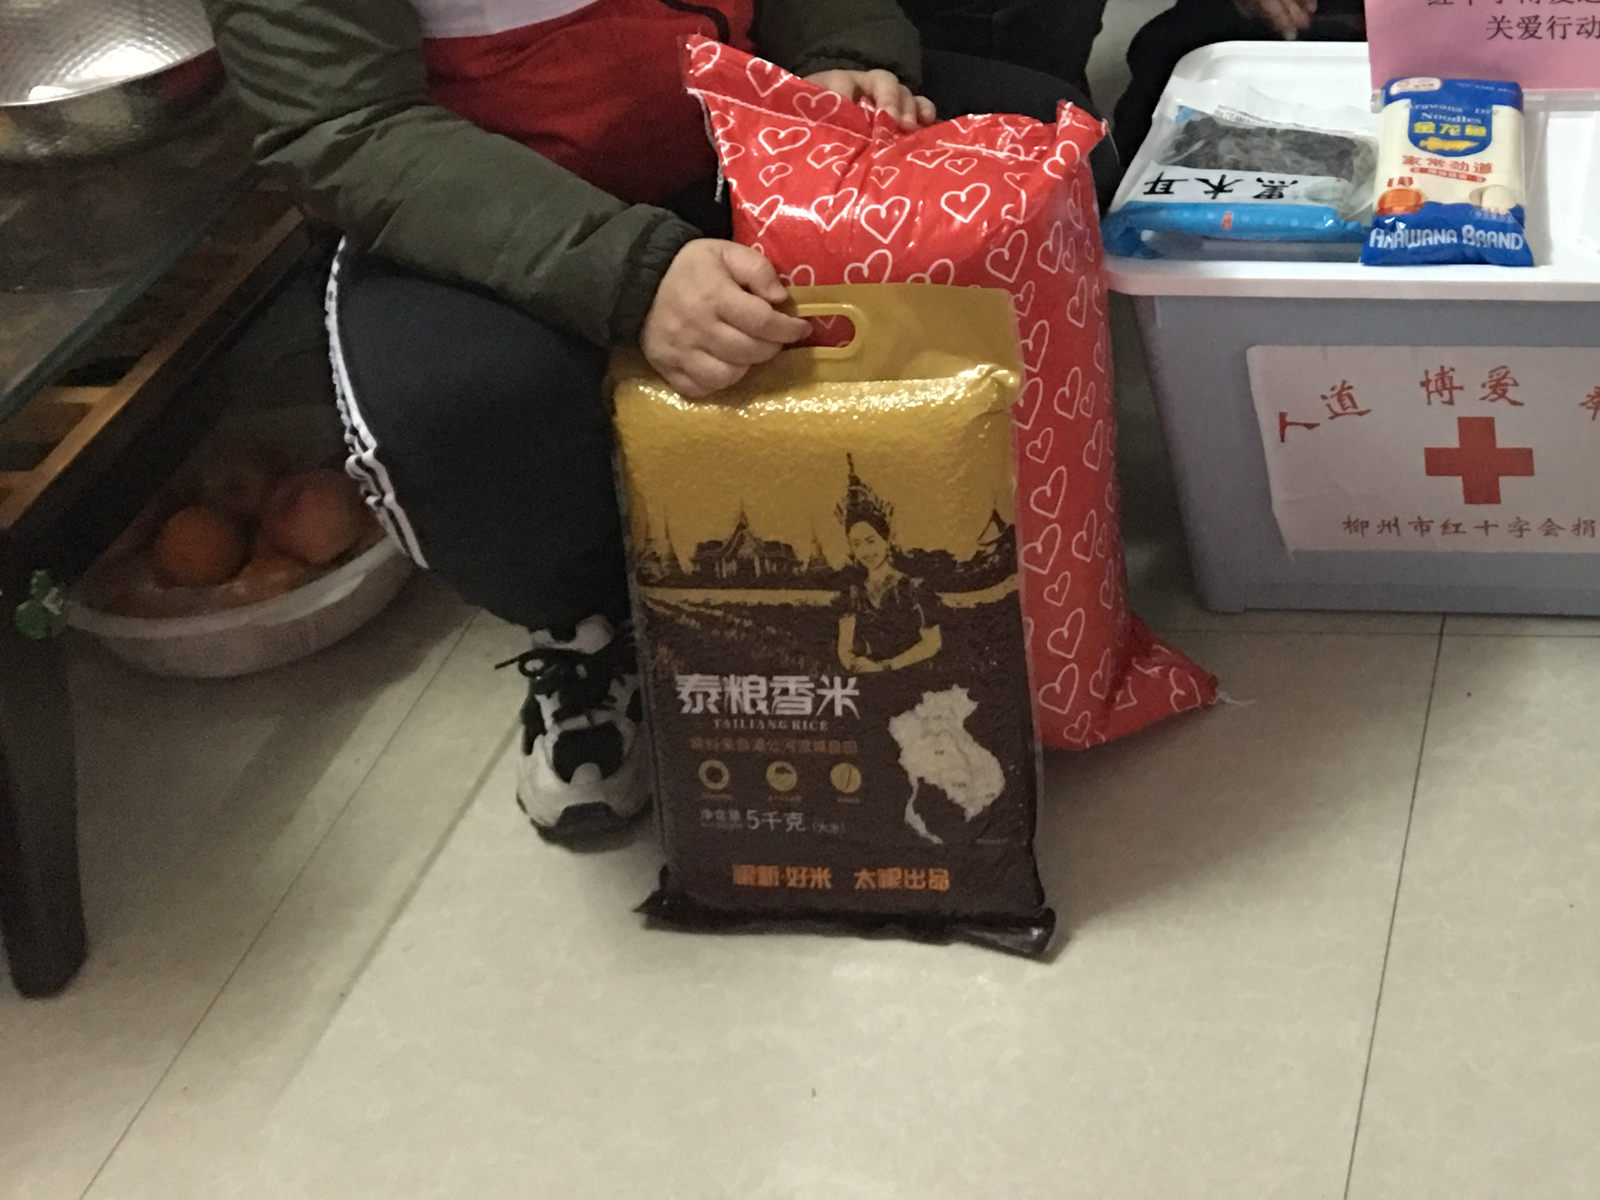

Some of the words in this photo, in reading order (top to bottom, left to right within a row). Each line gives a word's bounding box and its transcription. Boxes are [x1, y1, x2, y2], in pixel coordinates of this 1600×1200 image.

[1421, 111, 1482, 124] Noodles
[1402, 154, 1493, 175] 家常劲道
[1142, 171, 1299, 200] 黑木耳
[1461, 224, 1524, 251] BRAND
[1418, 365, 1525, 407] 博爱
[674, 673, 861, 720] 泰粮香米
